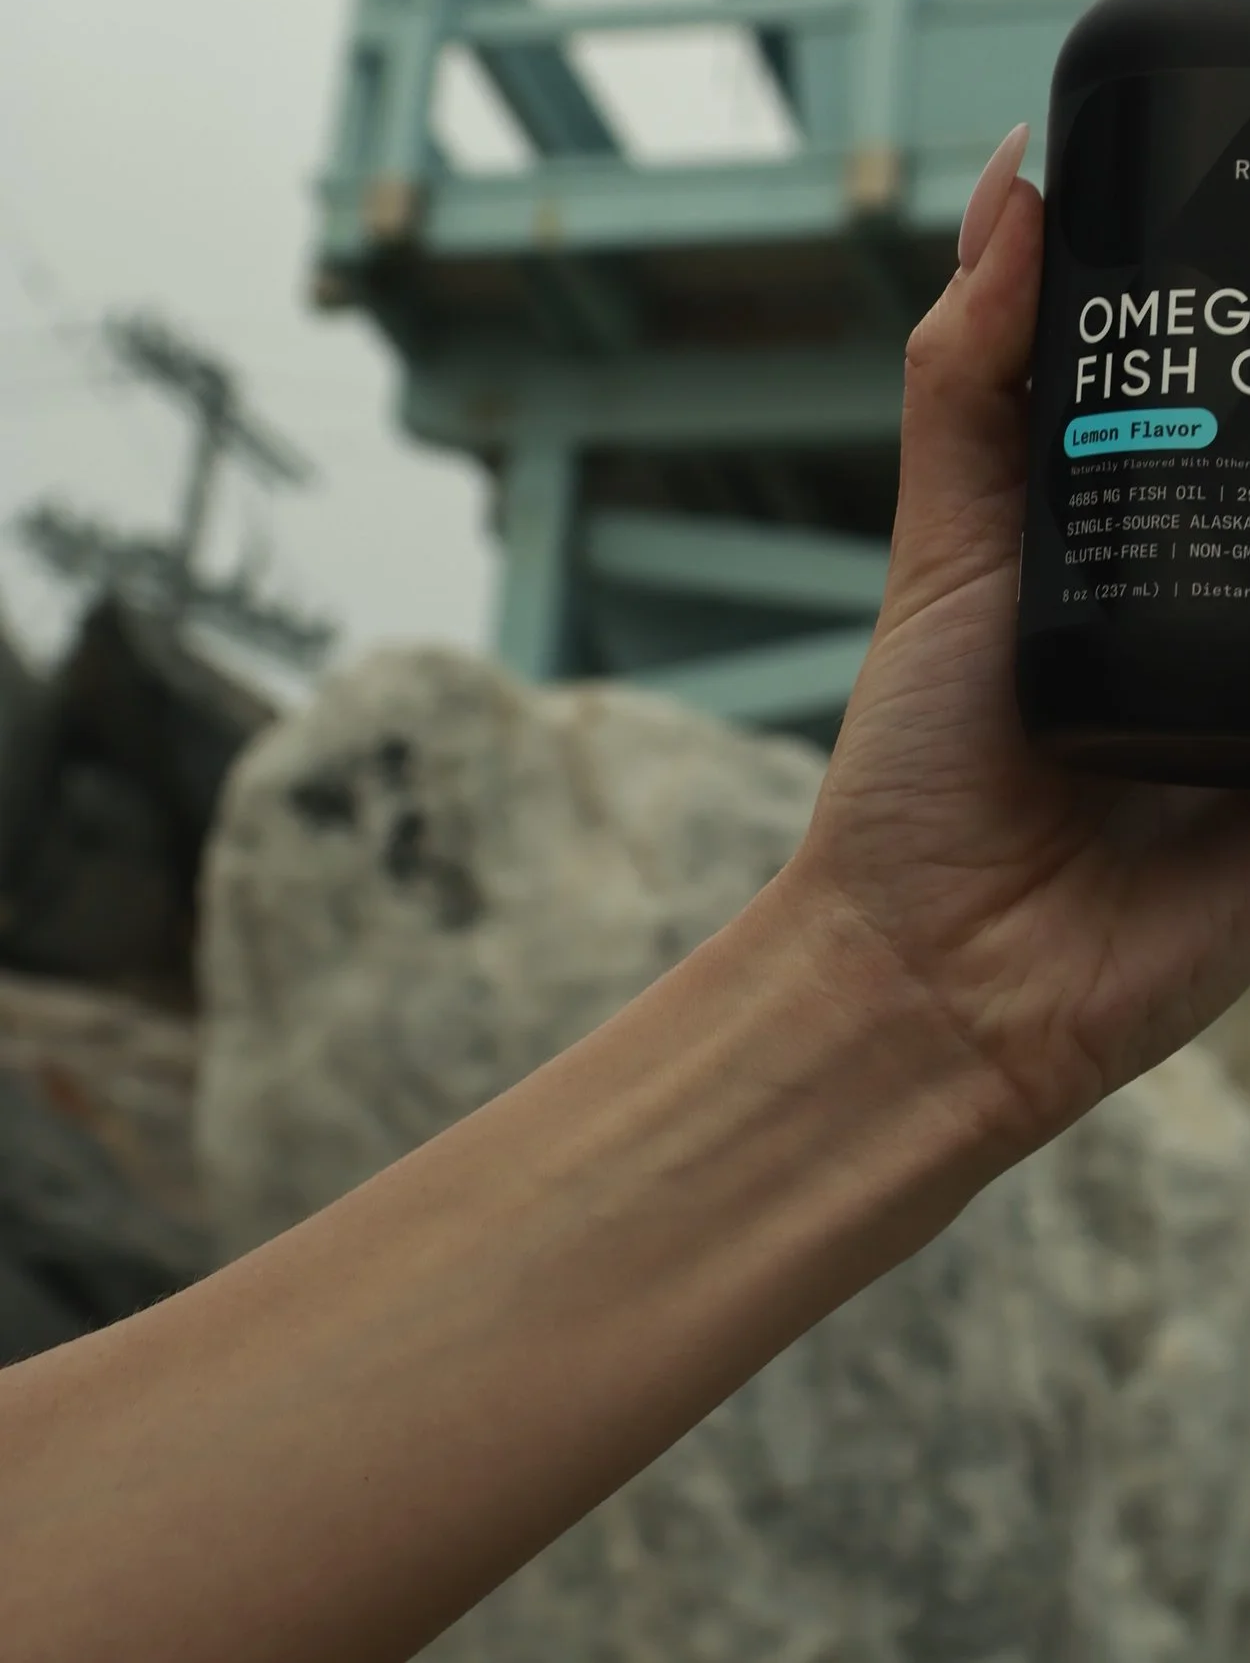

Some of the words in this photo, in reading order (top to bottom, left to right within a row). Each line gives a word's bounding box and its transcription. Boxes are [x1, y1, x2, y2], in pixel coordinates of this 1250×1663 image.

[1075, 346, 1198, 404] FISH
[1072, 428, 1120, 447] Lemon
[1130, 421, 1203, 440] Flavor
[1123, 457, 1176, 469] Flavored
[1181, 457, 1210, 468] With
[1215, 457, 1250, 469] Other
[1068, 490, 1099, 508] 4685
[1102, 488, 1121, 503] MG
[1128, 485, 1168, 502] FISH
[1175, 485, 1207, 501] OIL
[1066, 513, 1181, 537] SINGLE-SOURCE
[1065, 542, 1159, 565] GLUTEN-FREE
[1062, 588, 1070, 603] 8
[1073, 588, 1089, 601] oz
[1094, 582, 1128, 600] (237
[1132, 581, 1160, 598] mL)
